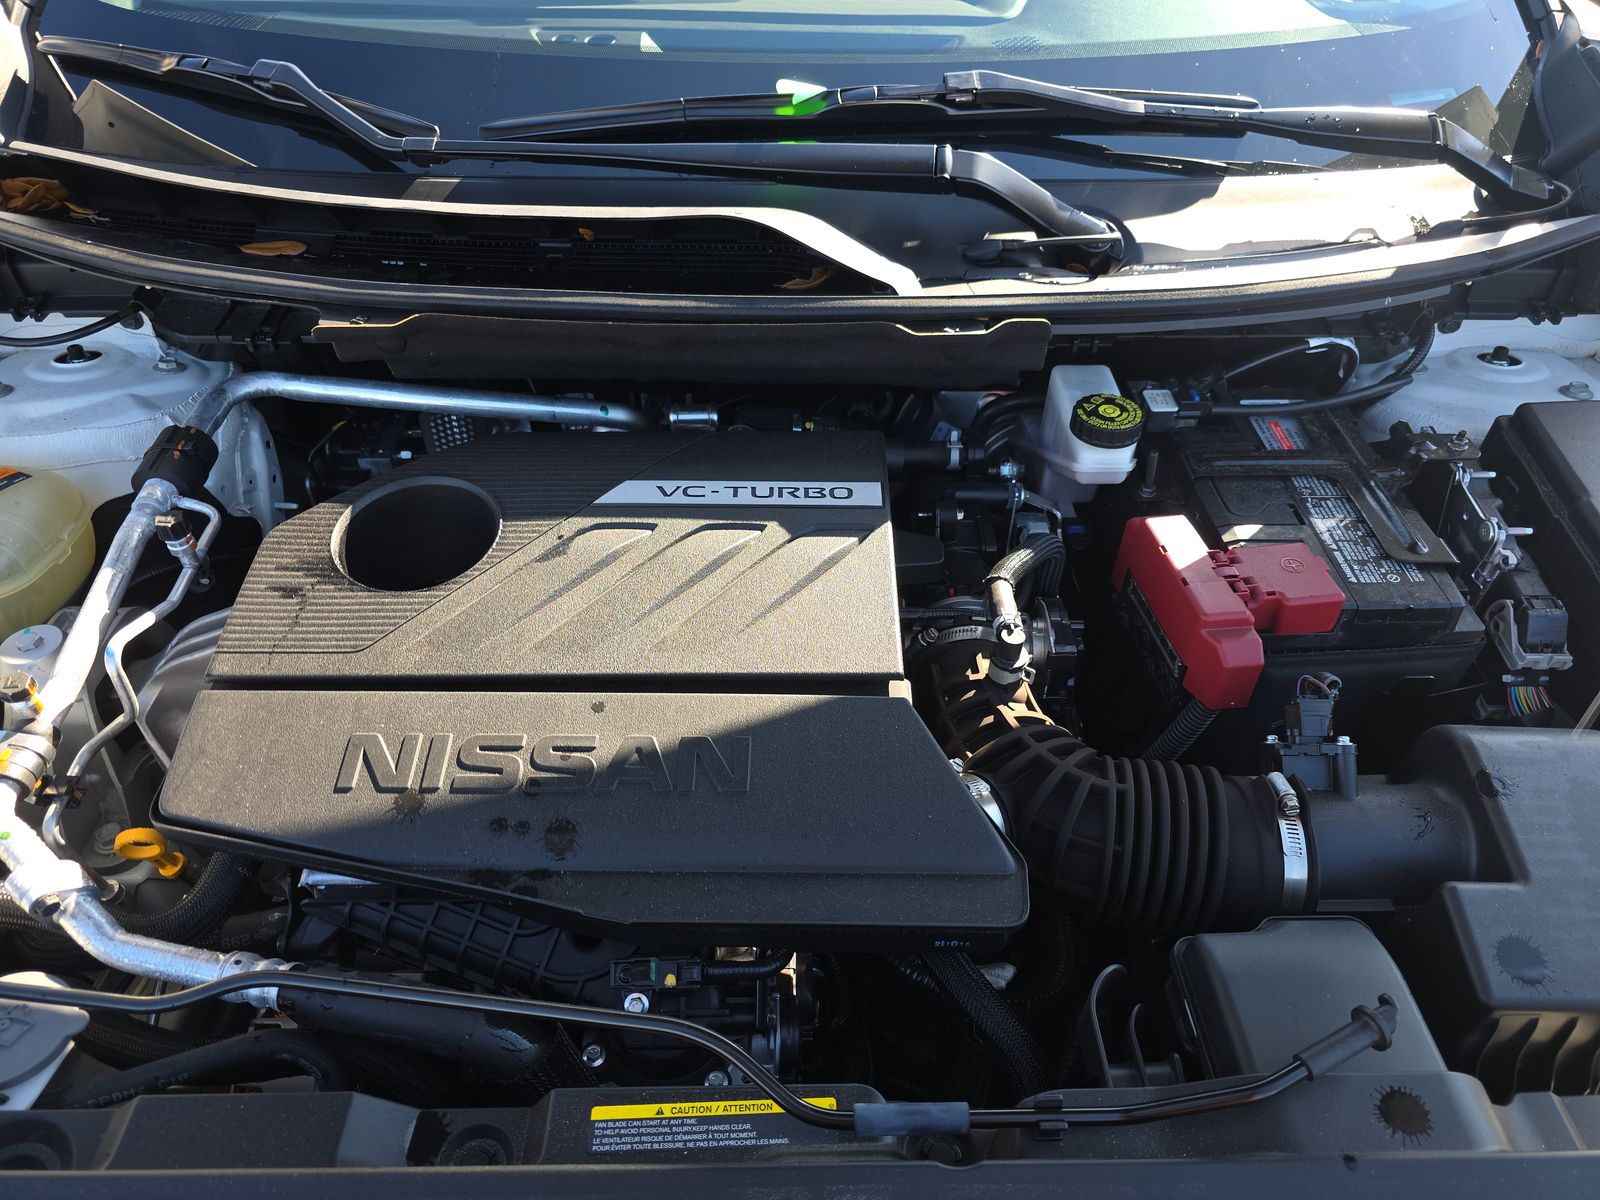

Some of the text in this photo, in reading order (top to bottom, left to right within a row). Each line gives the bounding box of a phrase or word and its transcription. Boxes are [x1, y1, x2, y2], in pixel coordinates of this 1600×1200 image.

[655, 485, 854, 500] VC-TURBO
[332, 732, 752, 794] NISSAN
[670, 1105, 713, 1115] CAUTION
[722, 1103, 774, 1113] ATTENTION
[639, 1126, 671, 1134] PERSONAL
[601, 1135, 641, 1143] VENTILATEUR
[674, 1132, 707, 1141] DÉMARRER
[592, 1144, 611, 1152] POUR
[611, 1142, 632, 1151] ÉVITER
[718, 1138, 756, 1146] APPROCHER
